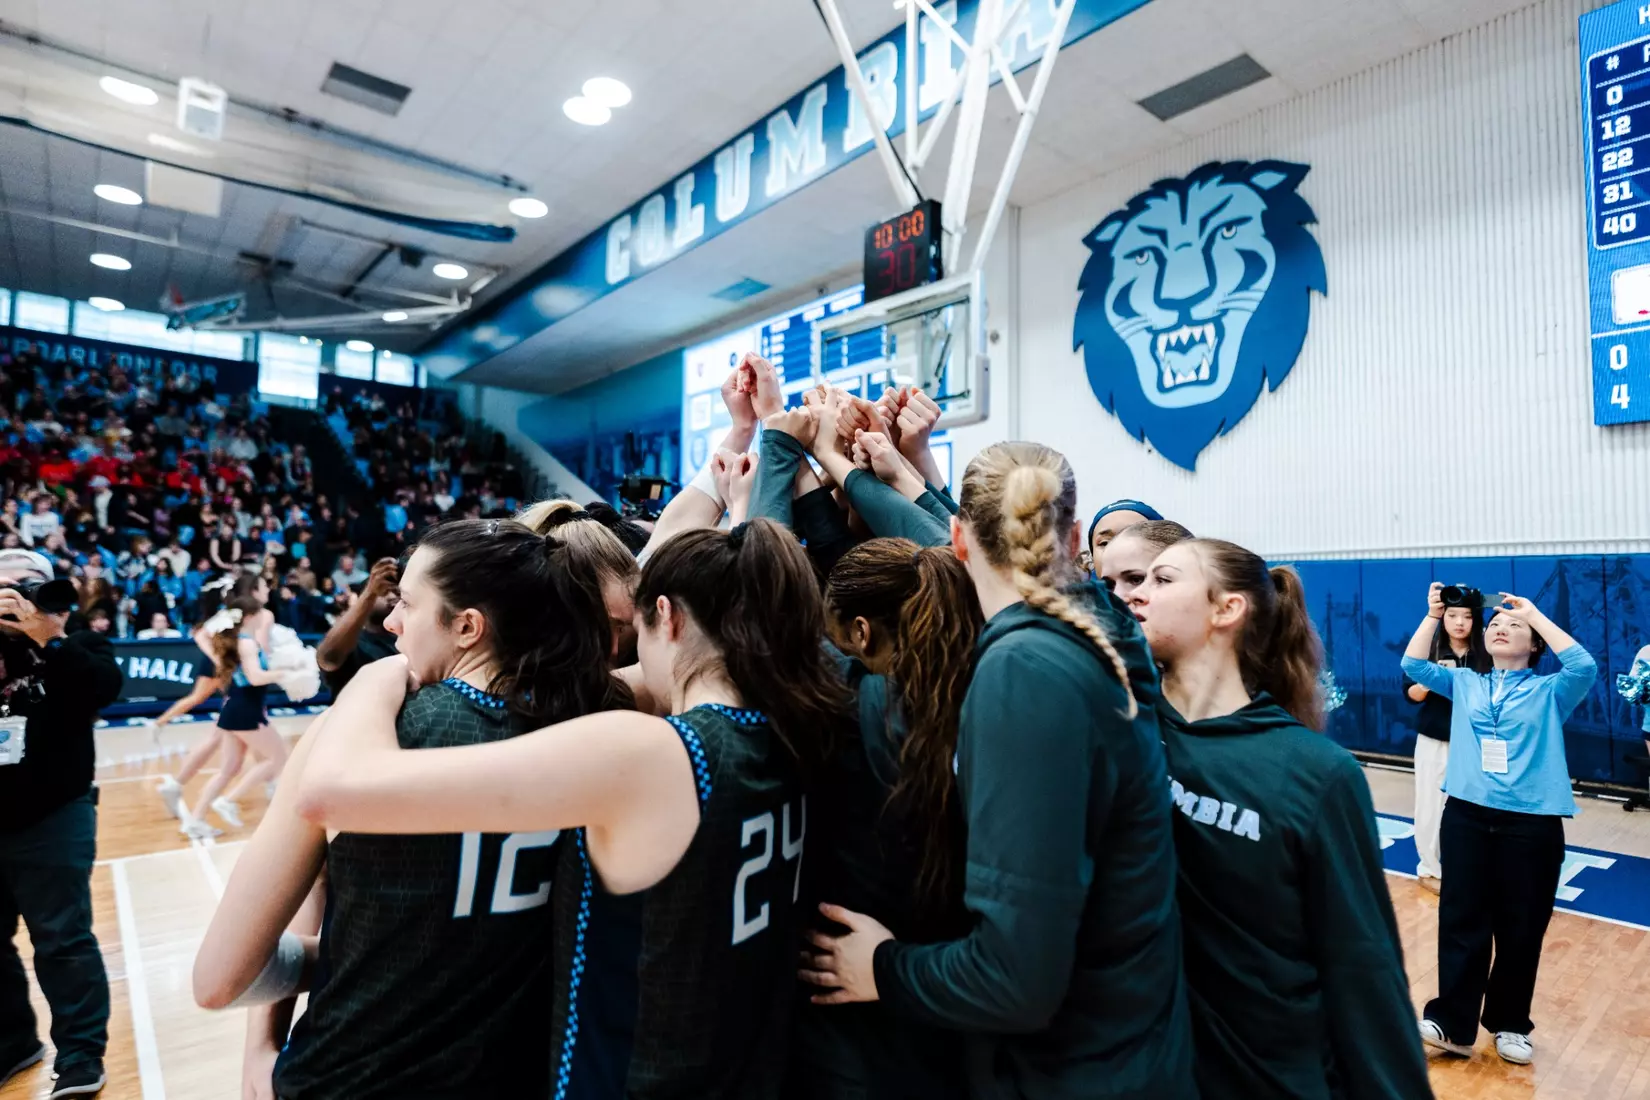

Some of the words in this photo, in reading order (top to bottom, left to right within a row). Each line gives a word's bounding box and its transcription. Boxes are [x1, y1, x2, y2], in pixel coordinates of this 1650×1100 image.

[1606, 84, 1624, 106] 0
[1601, 114, 1631, 140] 12
[605, 0, 1062, 285] COLUMBIA
[1602, 147, 1634, 173] 22
[1603, 212, 1636, 235] 40
[878, 242, 916, 295] 30
[1609, 344, 1628, 370] 0
[1610, 383, 1630, 410] 4
[128, 656, 195, 685] HALL
[1167, 775, 1261, 842] MBIA
[453, 829, 561, 919] 12
[731, 795, 807, 945] 24
